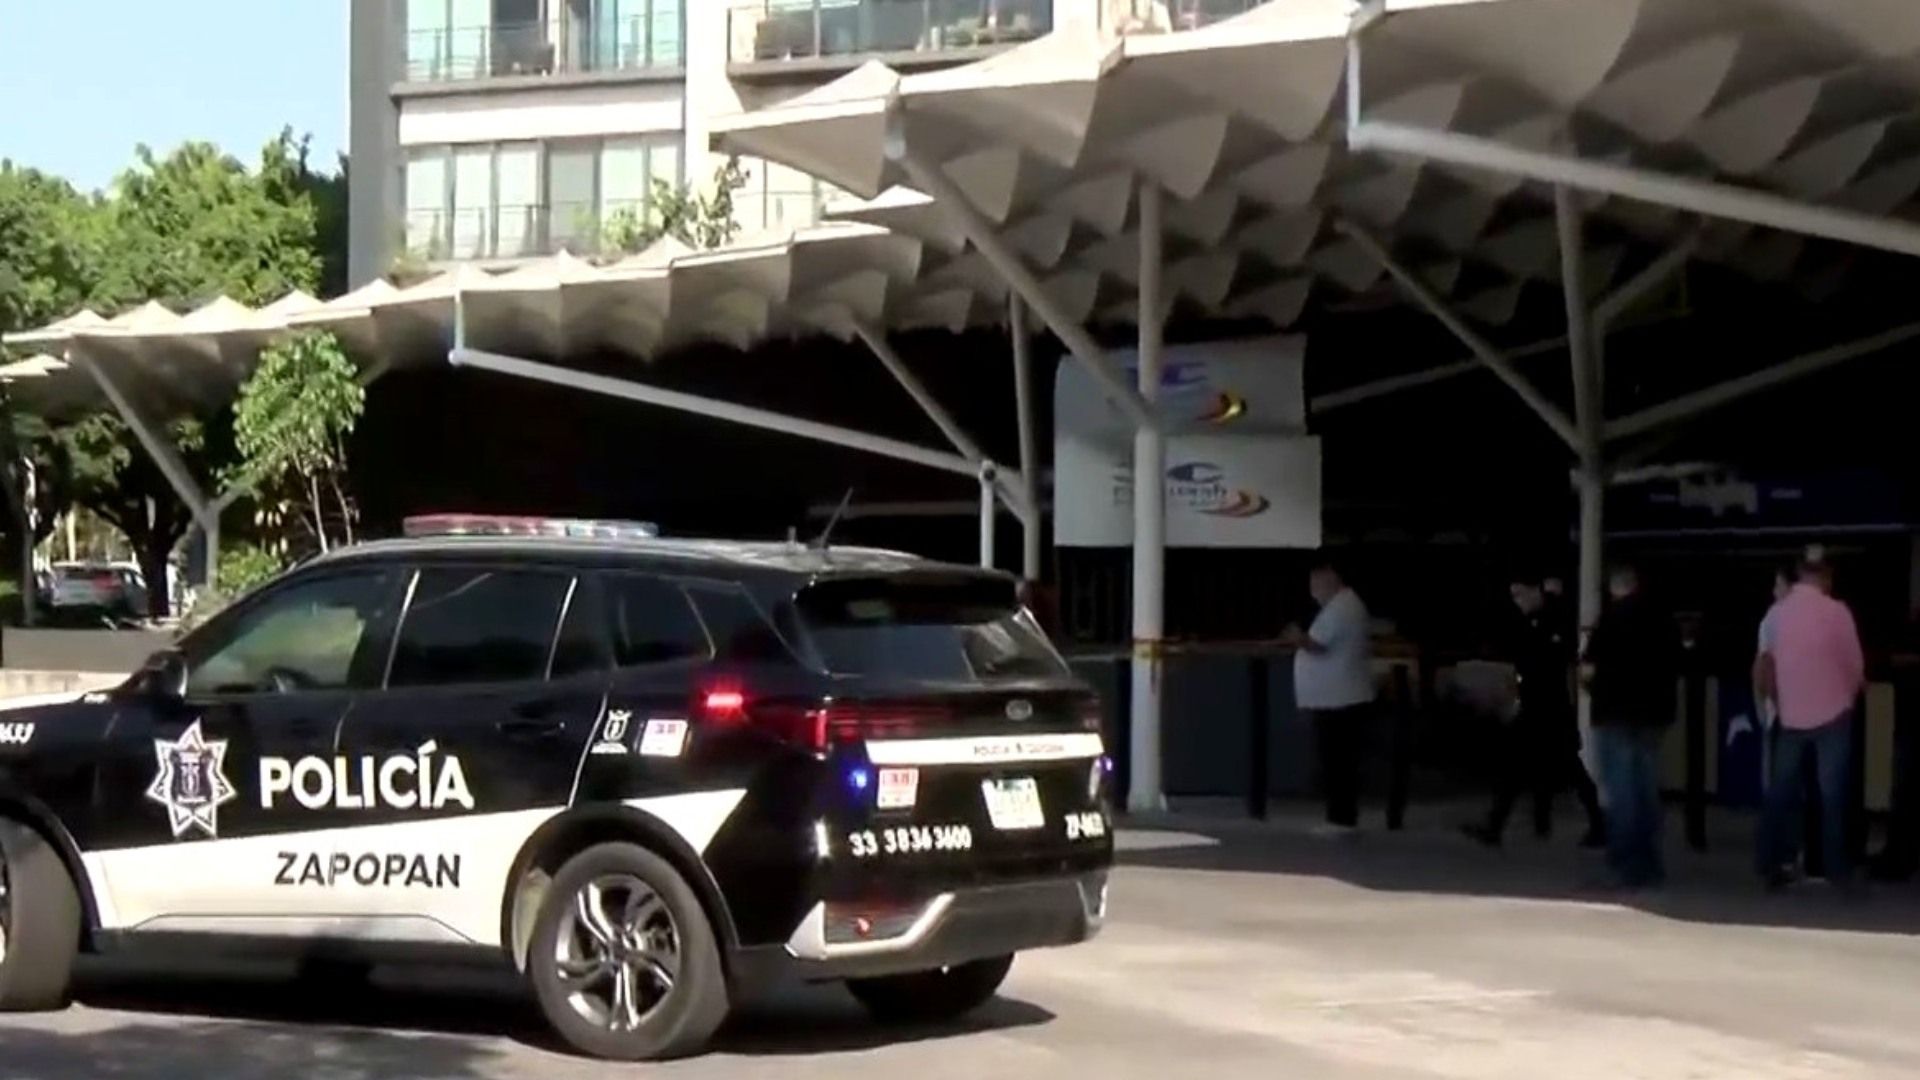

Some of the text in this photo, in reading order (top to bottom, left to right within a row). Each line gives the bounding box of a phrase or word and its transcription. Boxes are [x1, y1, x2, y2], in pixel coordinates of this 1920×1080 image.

[259, 739, 475, 809] POLICÍA
[849, 830, 878, 857] 33
[274, 850, 461, 888] ZAPOPAN
